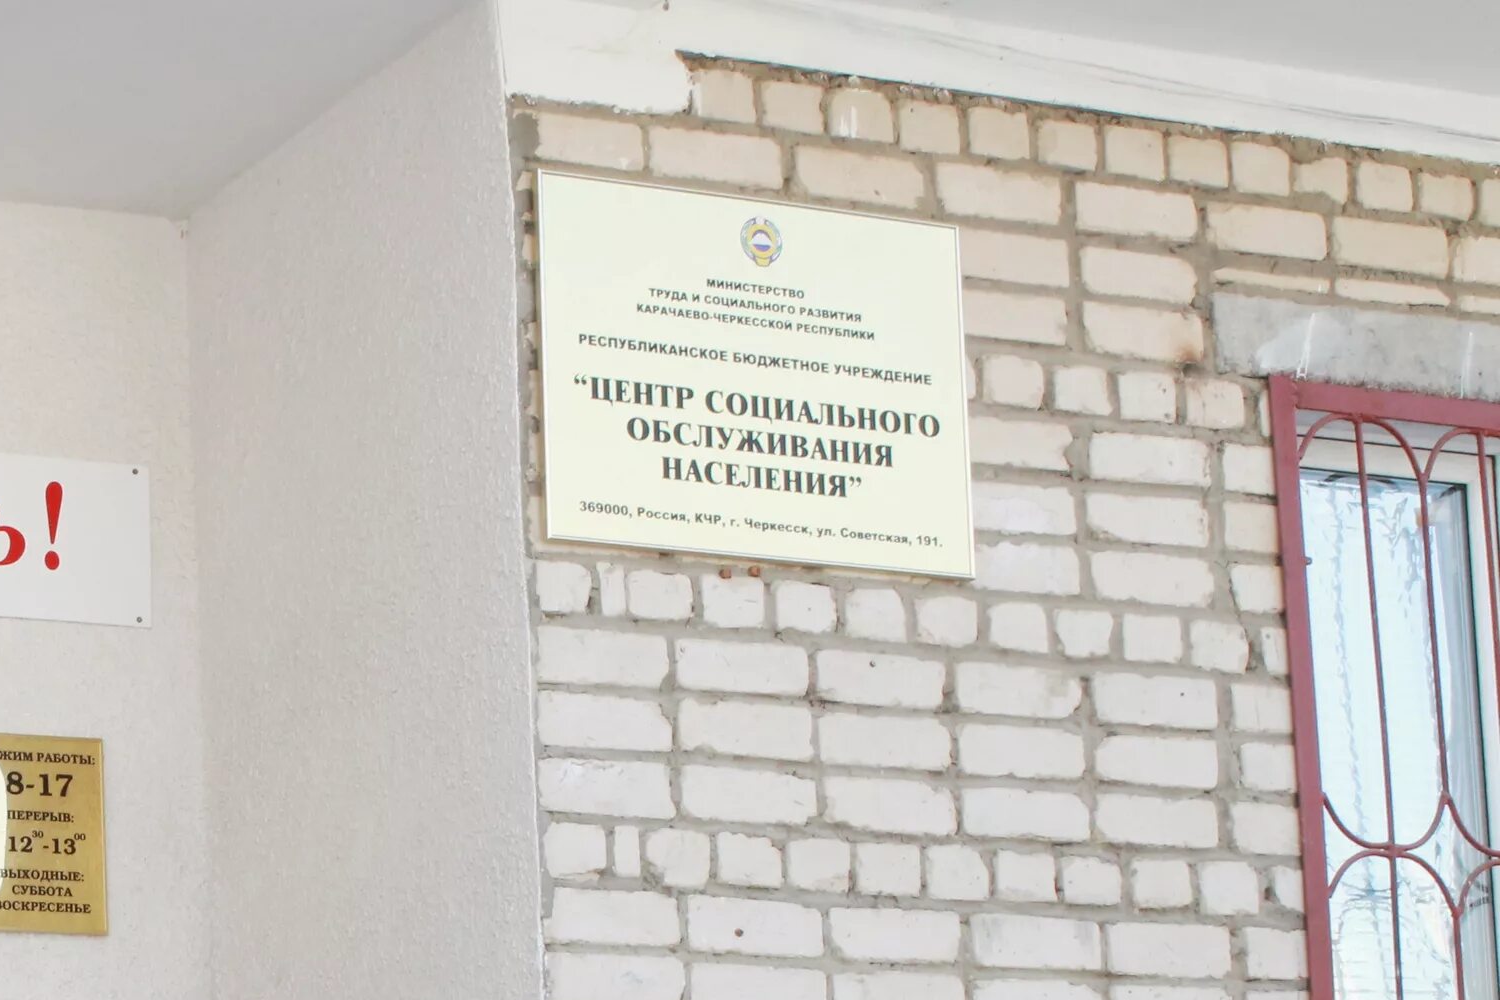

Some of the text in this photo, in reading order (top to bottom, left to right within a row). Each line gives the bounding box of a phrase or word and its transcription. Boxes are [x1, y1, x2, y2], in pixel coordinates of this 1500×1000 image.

[705, 278, 806, 300] МИНИСТЕРСТВО
[648, 287, 863, 323] ТРУДА И СОЦИАЛЬНОГО РАЗВИТИЯ
[636, 303, 876, 341] КАРАЧАЕВО-ЧЕРКЕССКОЙ РЕСПУБЛИКИ
[578, 333, 933, 386] РЕСПУБЛИКАНСКОЕ БЮДЖЕТНОЕ УЧРЕЖДЕНИЕ
[705, 390, 941, 438] СОЦИАЛЬНОГО
[626, 416, 894, 468] ОБСЛУЖИВАНИЯ
[579, 501, 943, 548] 369000, Россия, КЧР, г. Черкесск, ул. Советская, 191.
[37, 752, 96, 765] РАБОТЫ:
[6, 771, 73, 797] 8-17
[7, 810, 74, 823] ПЕРЕРЫВ:
[0, 869, 85, 882] ВЫХОДНЫЕ:
[12, 885, 73, 897] СУББОТА
